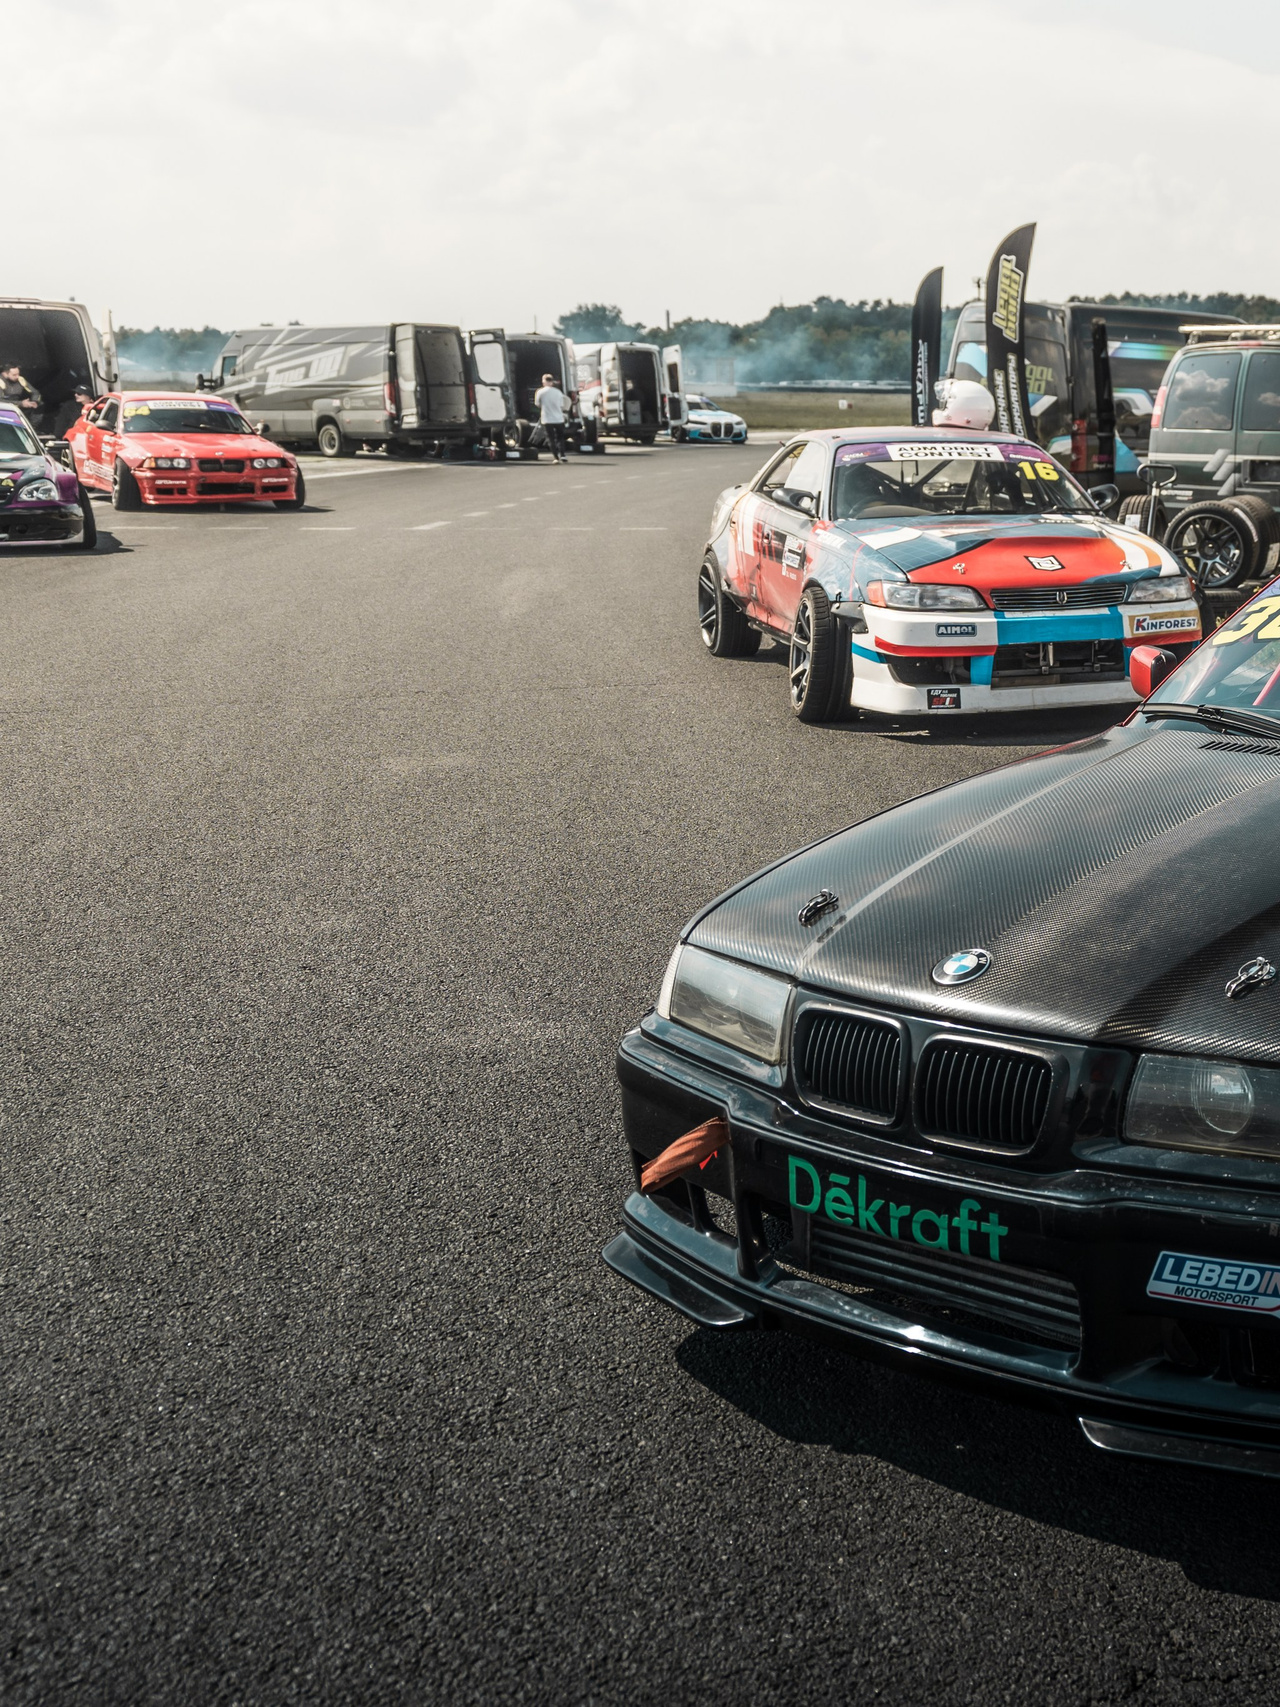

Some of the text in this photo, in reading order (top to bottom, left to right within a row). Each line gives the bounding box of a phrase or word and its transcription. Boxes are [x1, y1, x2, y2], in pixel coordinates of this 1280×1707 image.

[1017, 461, 1060, 481] 16
[938, 626, 975, 635] AIMOL
[1135, 618, 1197, 632] KINFOREST
[787, 1154, 1009, 1262] Dēkraft
[1173, 1285, 1259, 1306] MOTORSPORT
